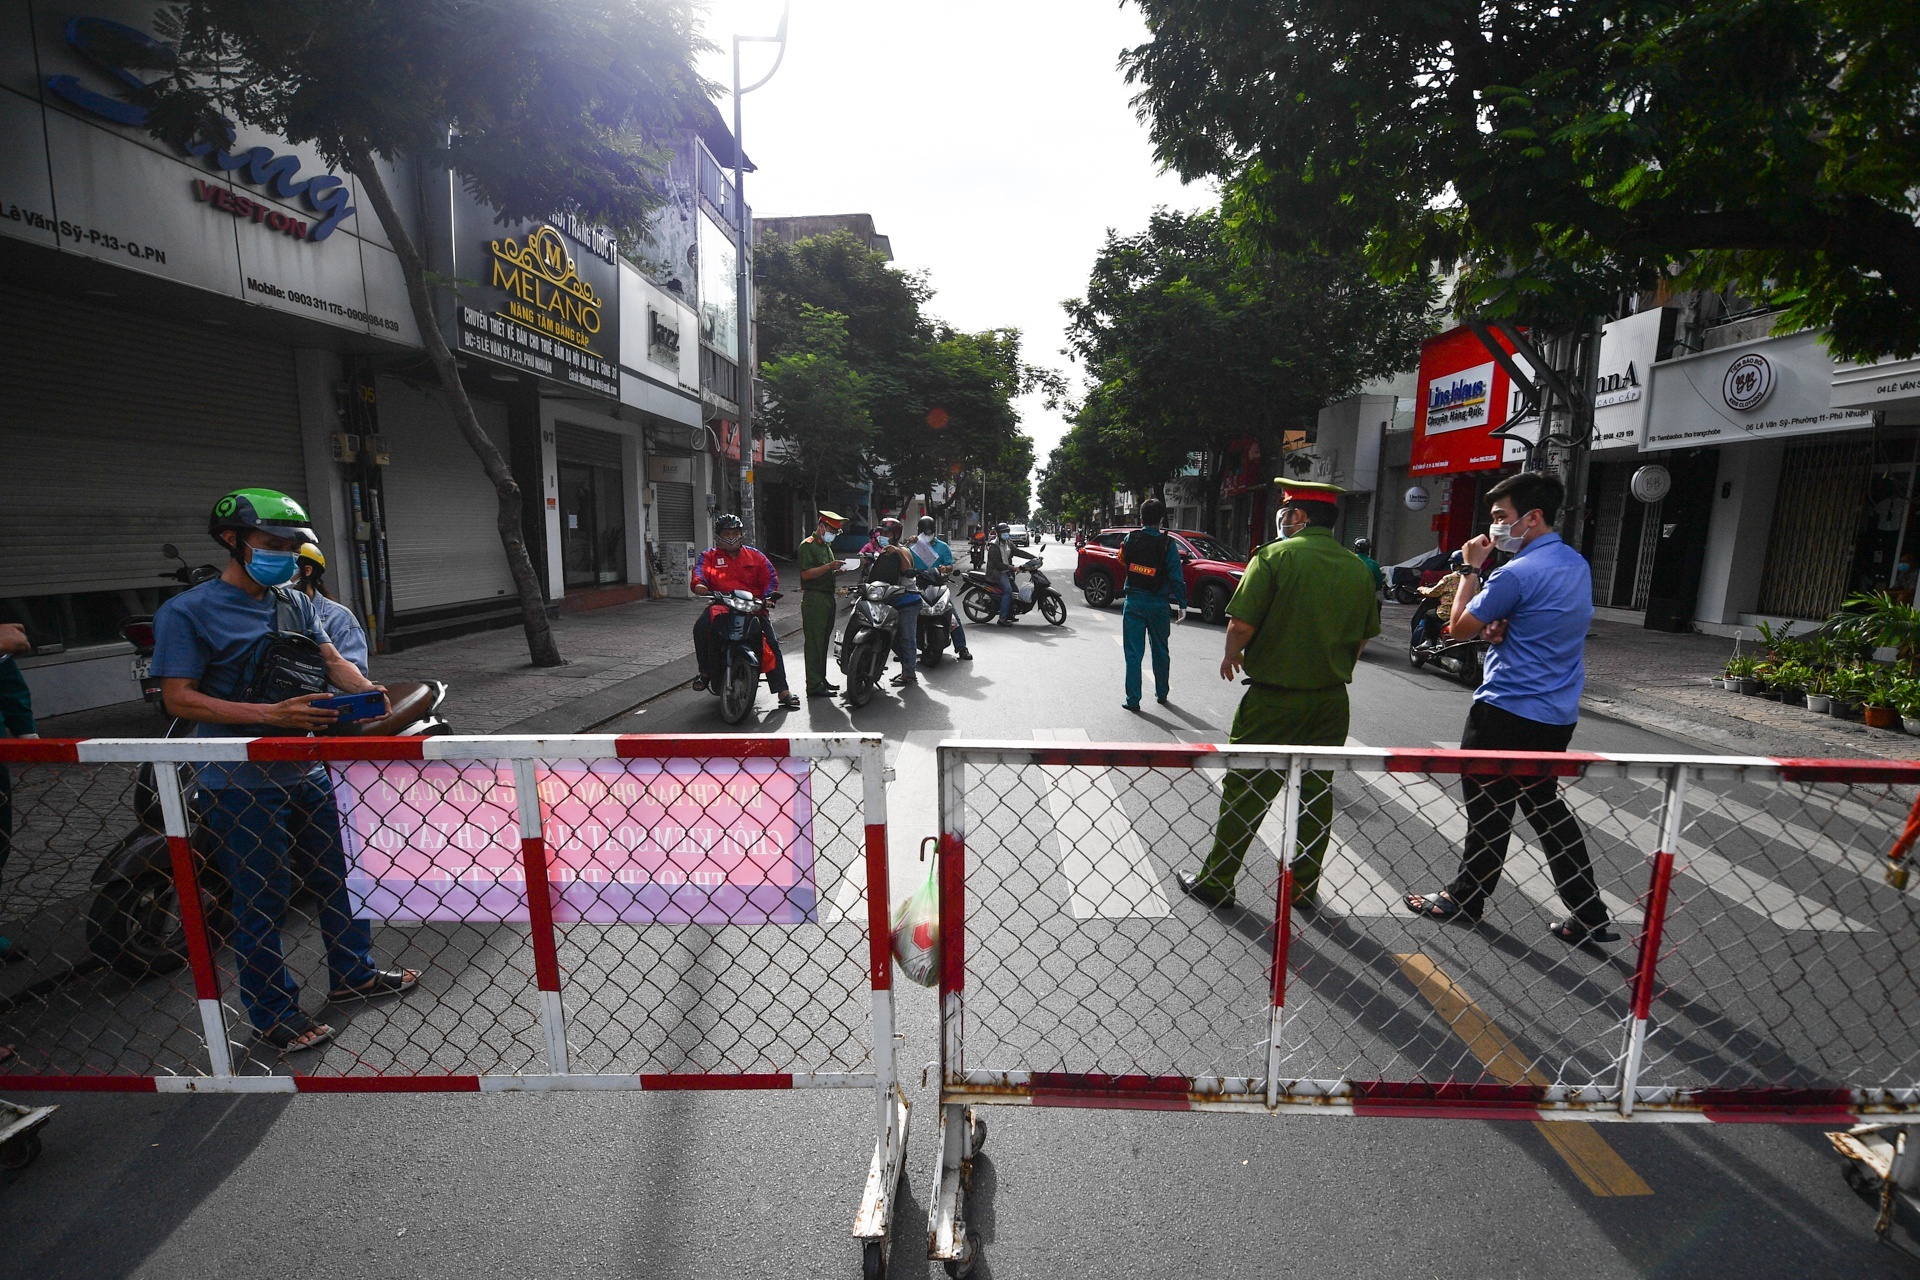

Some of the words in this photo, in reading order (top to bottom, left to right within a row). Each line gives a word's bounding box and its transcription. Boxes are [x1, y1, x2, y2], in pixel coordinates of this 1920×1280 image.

[0, 202, 21, 221] Lê
[22, 209, 57, 233] Văn
[198, 179, 307, 240] VESTON
[544, 237, 563, 273] M
[247, 277, 286, 299] Mobile:
[288, 289, 312, 306] 0903
[313, 297, 328, 312] 311
[493, 257, 601, 334] MELANO
[464, 306, 488, 331] CHUYÊN
[509, 301, 534, 323] NÂNG
[537, 310, 554, 333] TẦM
[481, 336, 490, 353] LÊ
[1739, 391, 1763, 407] CLOTHING
[1745, 423, 1754, 431] 06
[1721, 482, 1732, 499] 6
